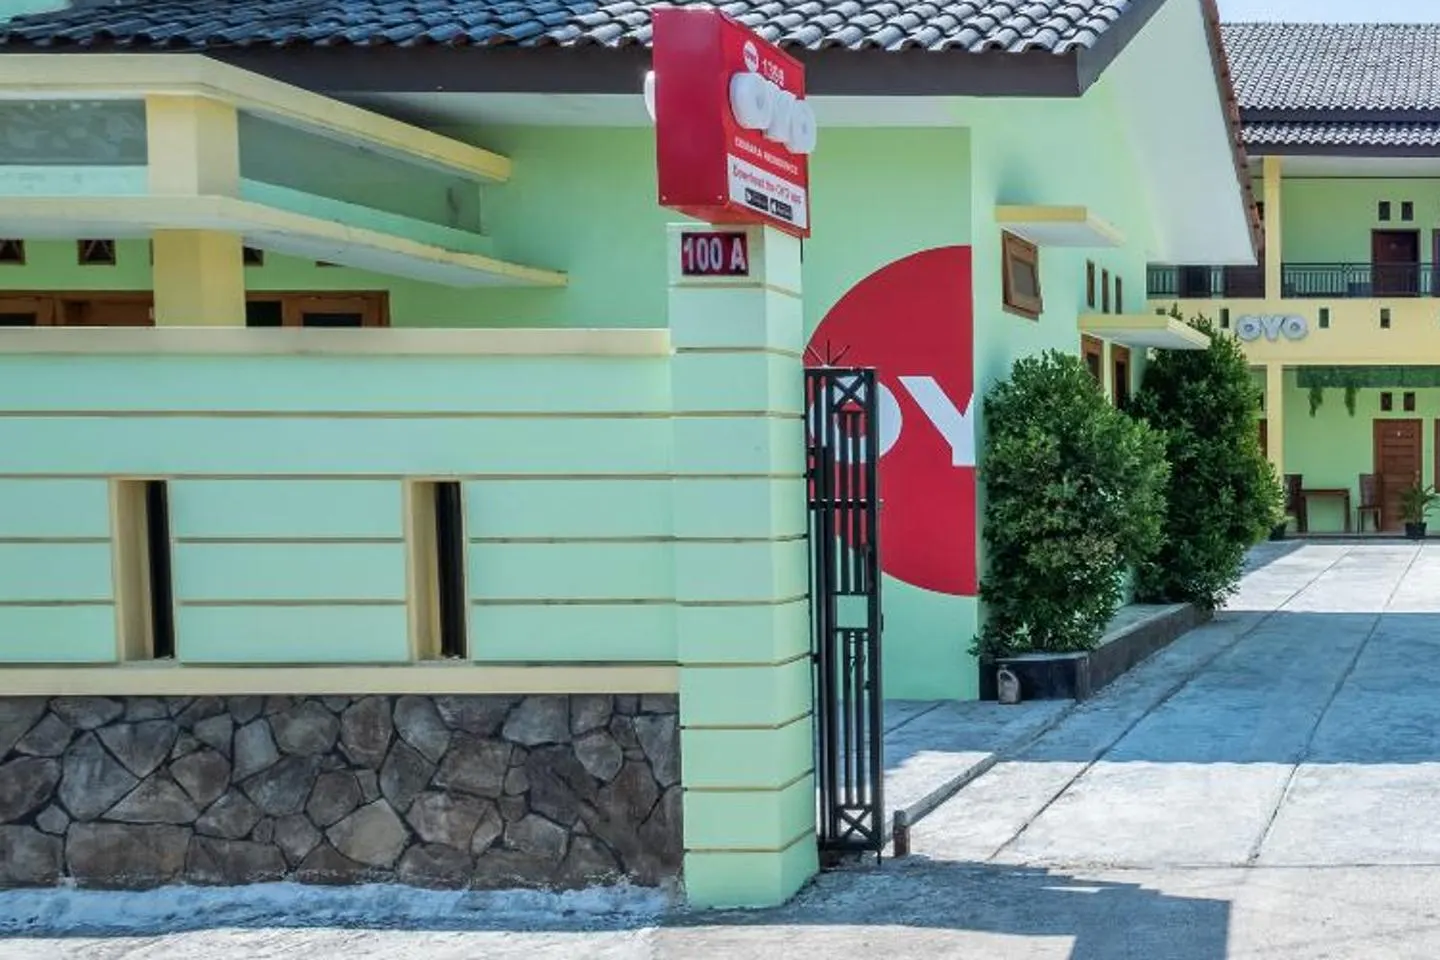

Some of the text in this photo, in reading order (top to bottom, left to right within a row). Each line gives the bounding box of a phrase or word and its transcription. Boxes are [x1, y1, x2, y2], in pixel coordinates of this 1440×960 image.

[729, 72, 817, 154] OYO
[683, 237, 746, 272] 100 A
[1236, 315, 1308, 343] OYO
